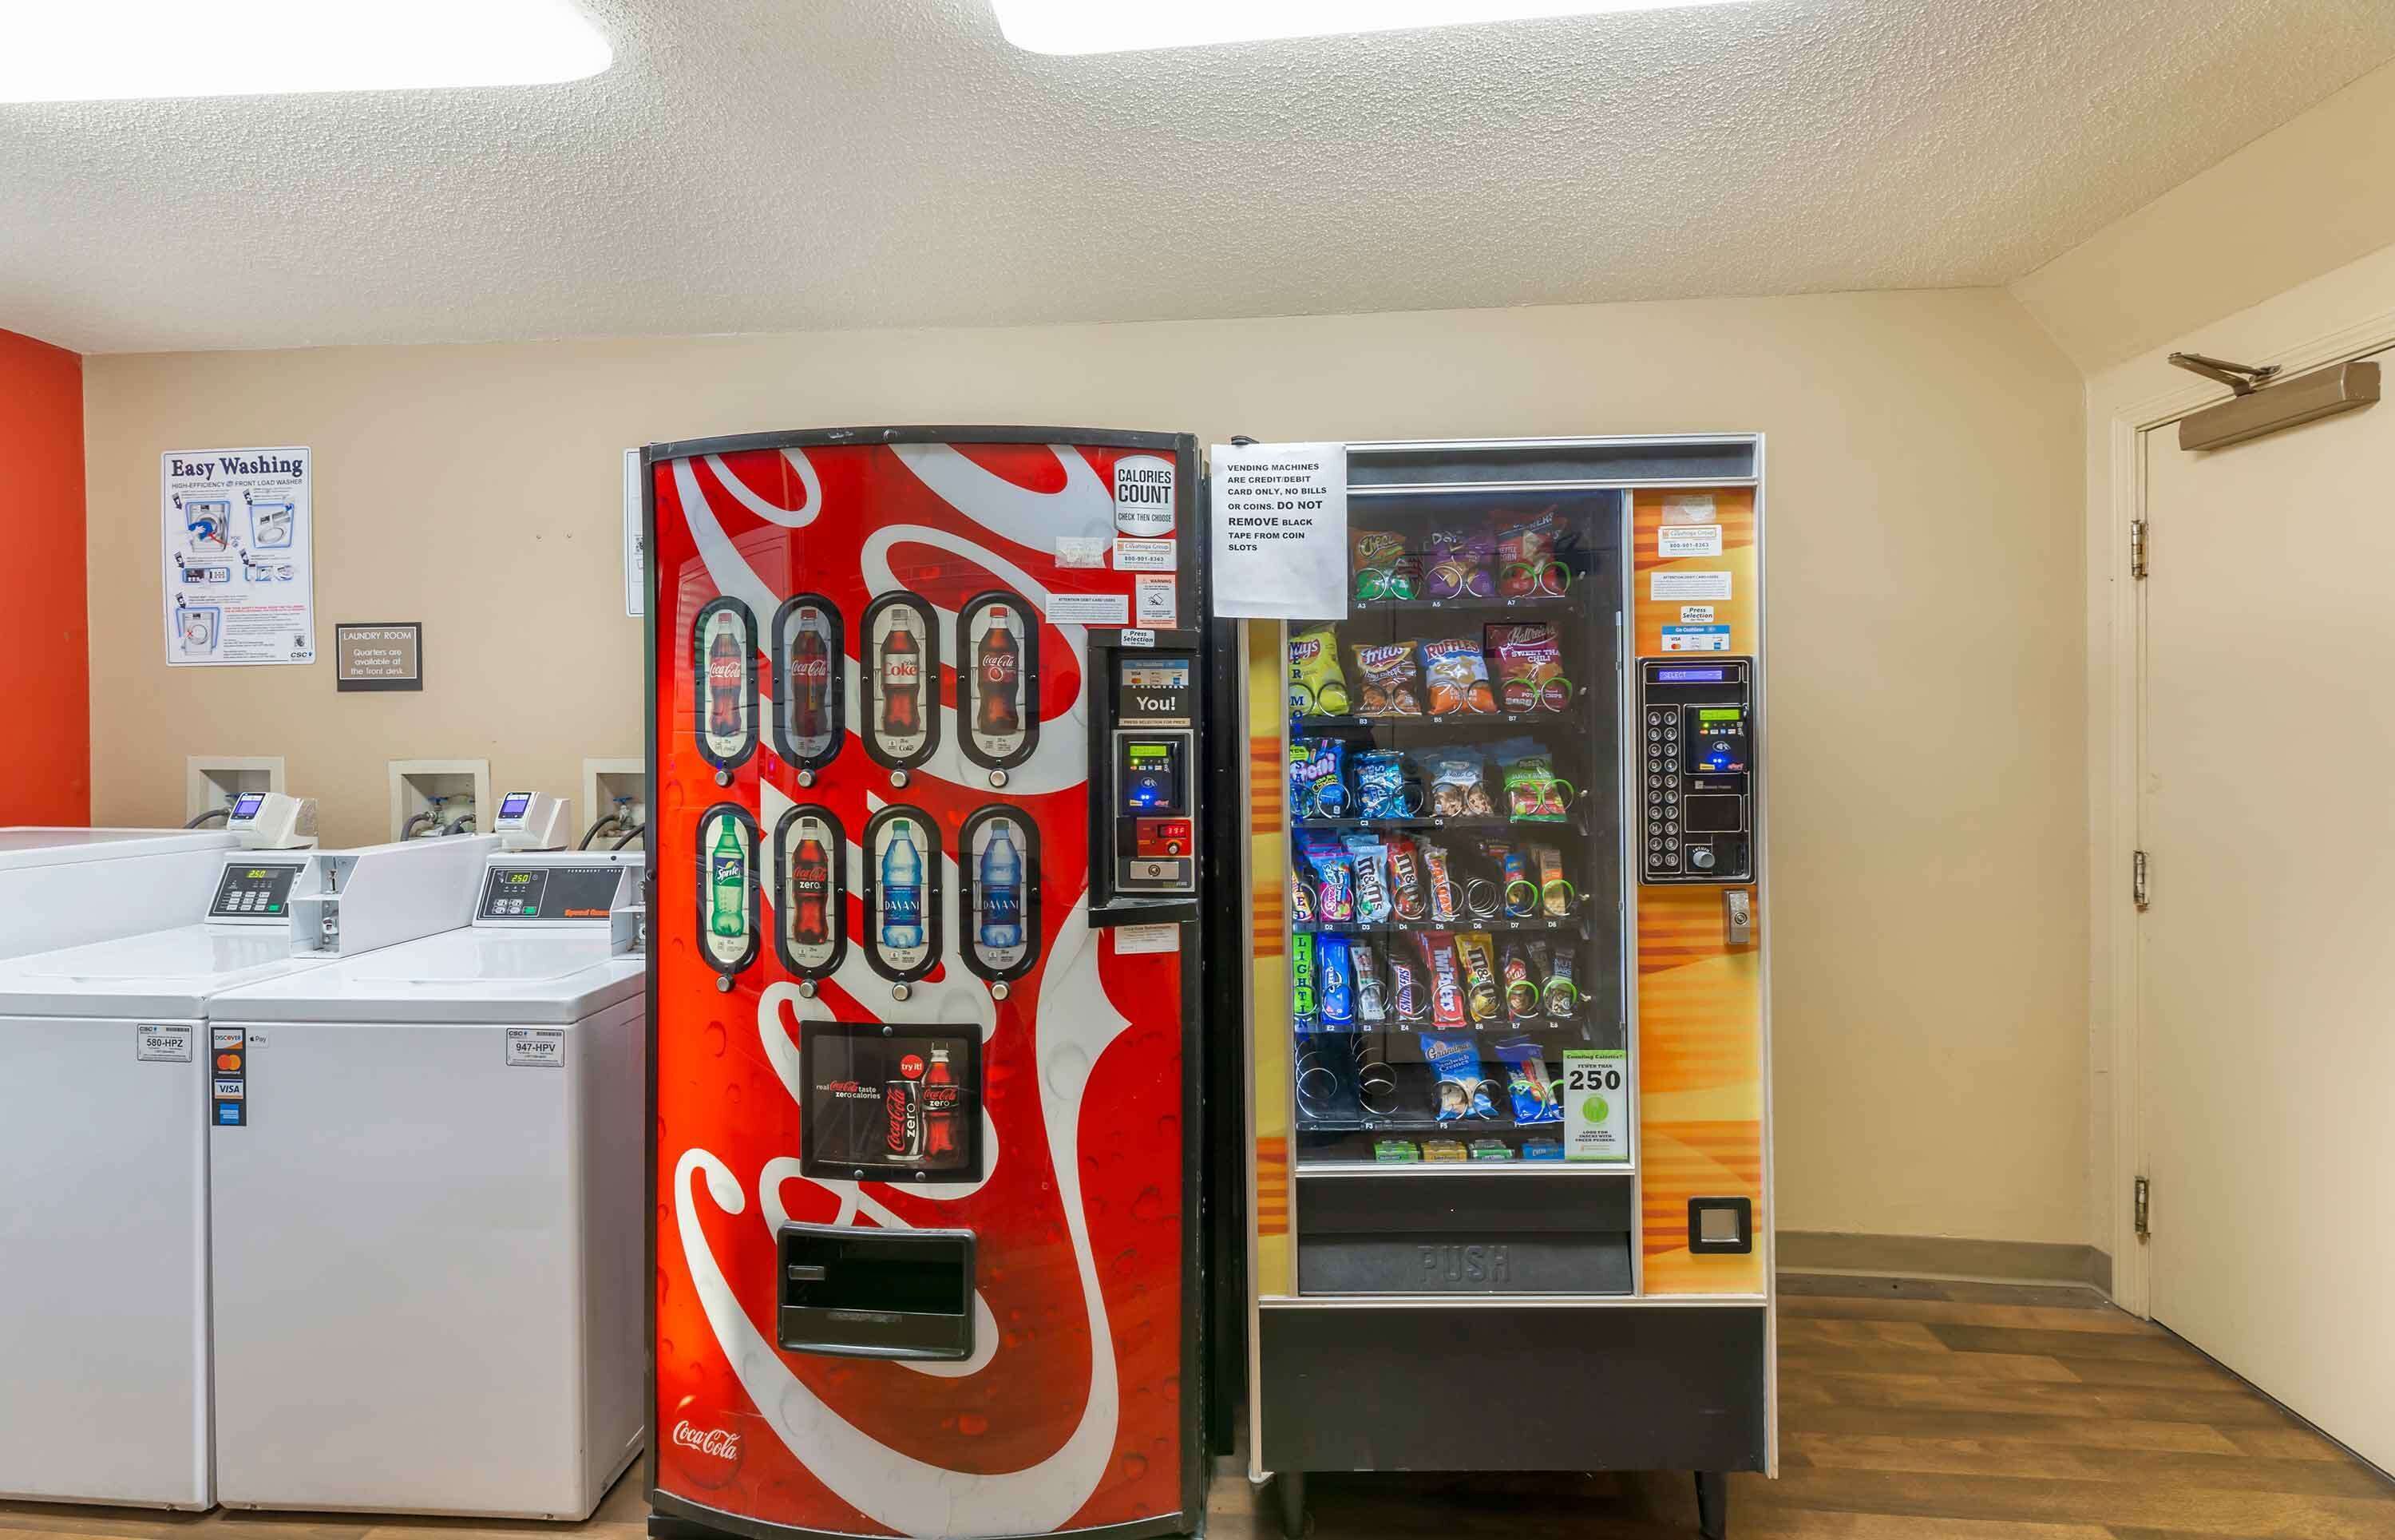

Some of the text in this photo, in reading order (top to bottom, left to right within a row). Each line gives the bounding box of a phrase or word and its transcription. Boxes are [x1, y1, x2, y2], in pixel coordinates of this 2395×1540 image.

[172, 456, 303, 481] Easy Washing
[1118, 469, 1172, 484] CALORIES
[1118, 484, 1171, 504] COUNT
[1297, 501, 1323, 509] NOT
[1118, 513, 1172, 523] CHECK THEN CHOOSE
[1229, 517, 1278, 526] REMOVE
[1360, 646, 1403, 665] Fritos
[1424, 639, 1479, 662] RUFFLES
[792, 659, 826, 677] Coca-Cola
[983, 654, 1015, 667] Coca-Cola
[710, 661, 741, 678] Coca-Cola
[883, 660, 918, 677] Coke
[1136, 696, 1176, 711] You!
[717, 865, 740, 881] Sprite
[793, 866, 826, 881] Coca-Cola
[800, 880, 820, 889] zero
[885, 900, 920, 911] DASANI
[984, 900, 1019, 910] DASANI
[147, 1039, 184, 1047] 580-HPZ
[516, 1043, 556, 1051] 947-HPV
[901, 1063, 912, 1072] try
[1436, 1054, 1470, 1068] Sandwich
[1439, 1059, 1470, 1072] Cremes
[829, 1080, 858, 1092] Coca-Cola
[1569, 1071, 1621, 1091] 250
[924, 1088, 956, 1100] Coca-Cola
[886, 1087, 906, 1151] Coca-Cola
[907, 1103, 916, 1138] zero
[1418, 1245, 1510, 1283] PUSH
[672, 1419, 741, 1460] Coca-Cola
